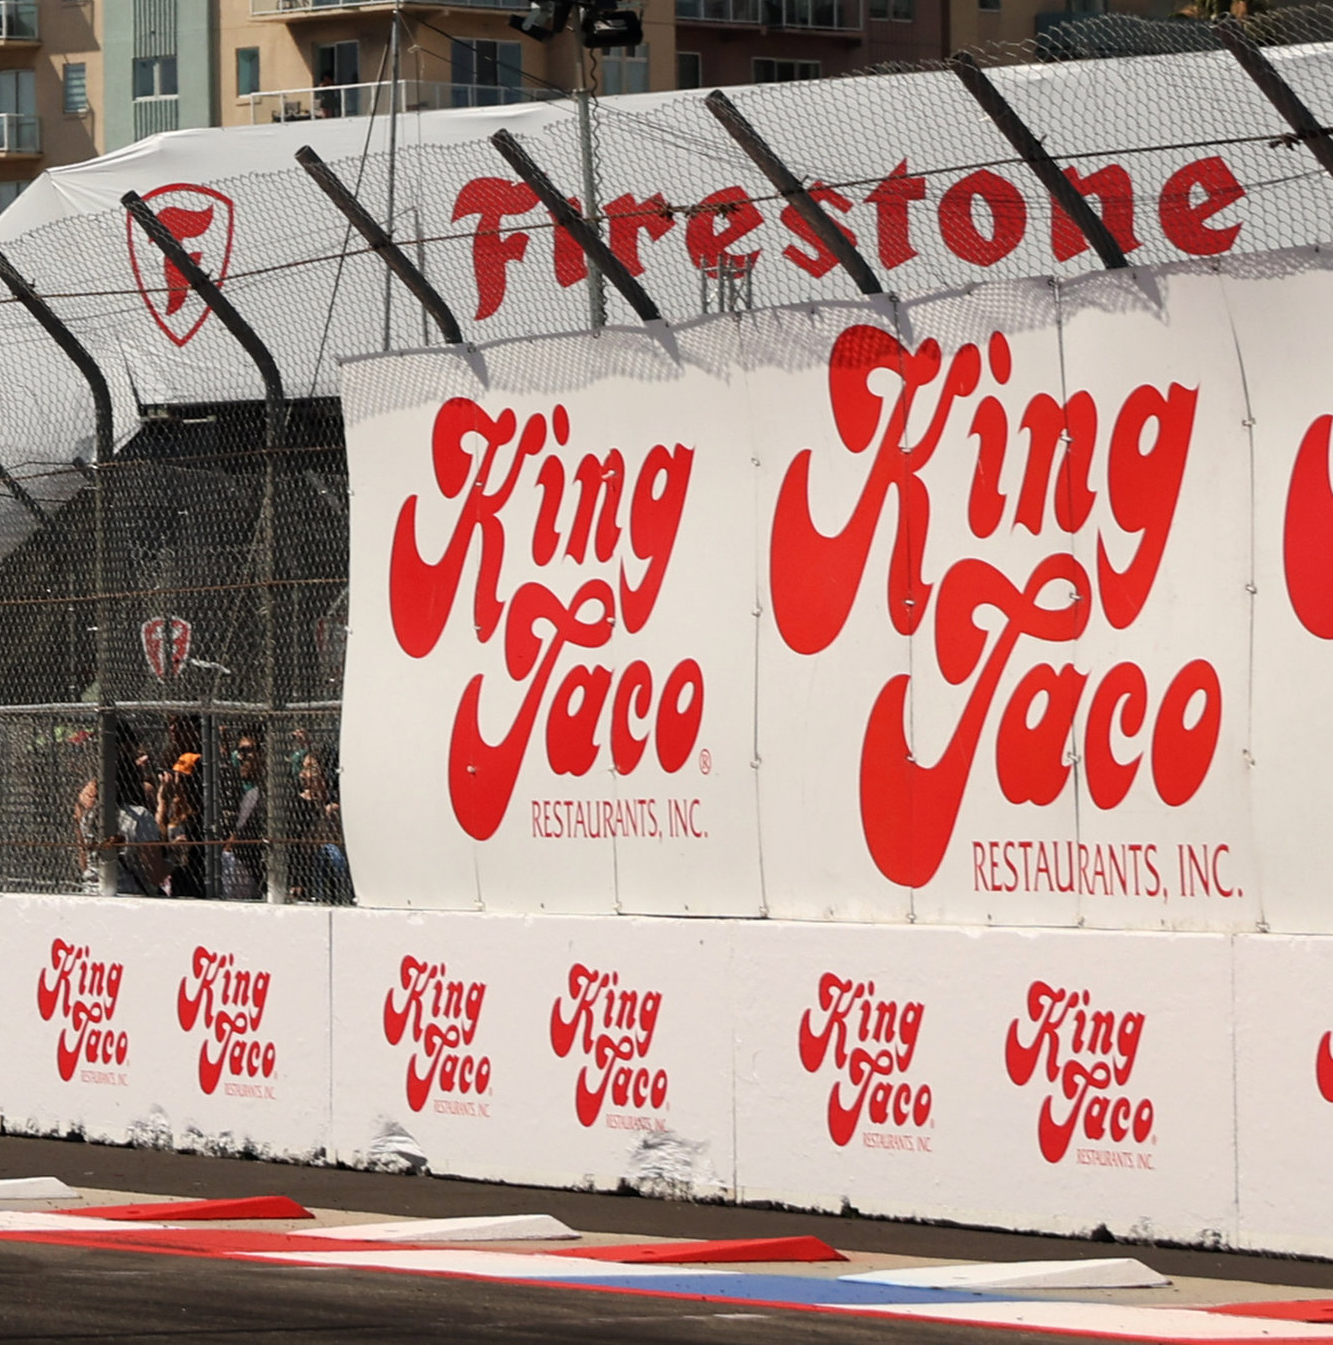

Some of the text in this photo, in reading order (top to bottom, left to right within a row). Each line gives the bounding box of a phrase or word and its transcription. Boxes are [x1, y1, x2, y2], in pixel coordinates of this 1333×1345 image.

[451, 156, 1247, 321] Firestone
[389, 396, 696, 658] King
[769, 324, 1200, 655] King
[448, 578, 705, 842] Taco
[859, 552, 1223, 890] Taco
[531, 798, 709, 843] RESTAURANTS, INC.
[972, 840, 1244, 904] RESTAURANTS, INC.
[37, 938, 124, 1021] King
[177, 945, 271, 1032] King
[384, 955, 487, 1046] King
[550, 963, 663, 1058] King
[798, 972, 926, 1073] King
[57, 1000, 128, 1082] Taco
[199, 1010, 276, 1095] Taco
[406, 1023, 491, 1112] Taco
[576, 1034, 668, 1127] Taco
[1005, 980, 1147, 1086] King
[828, 1047, 933, 1147] Taco
[1038, 1059, 1155, 1164] Taco
